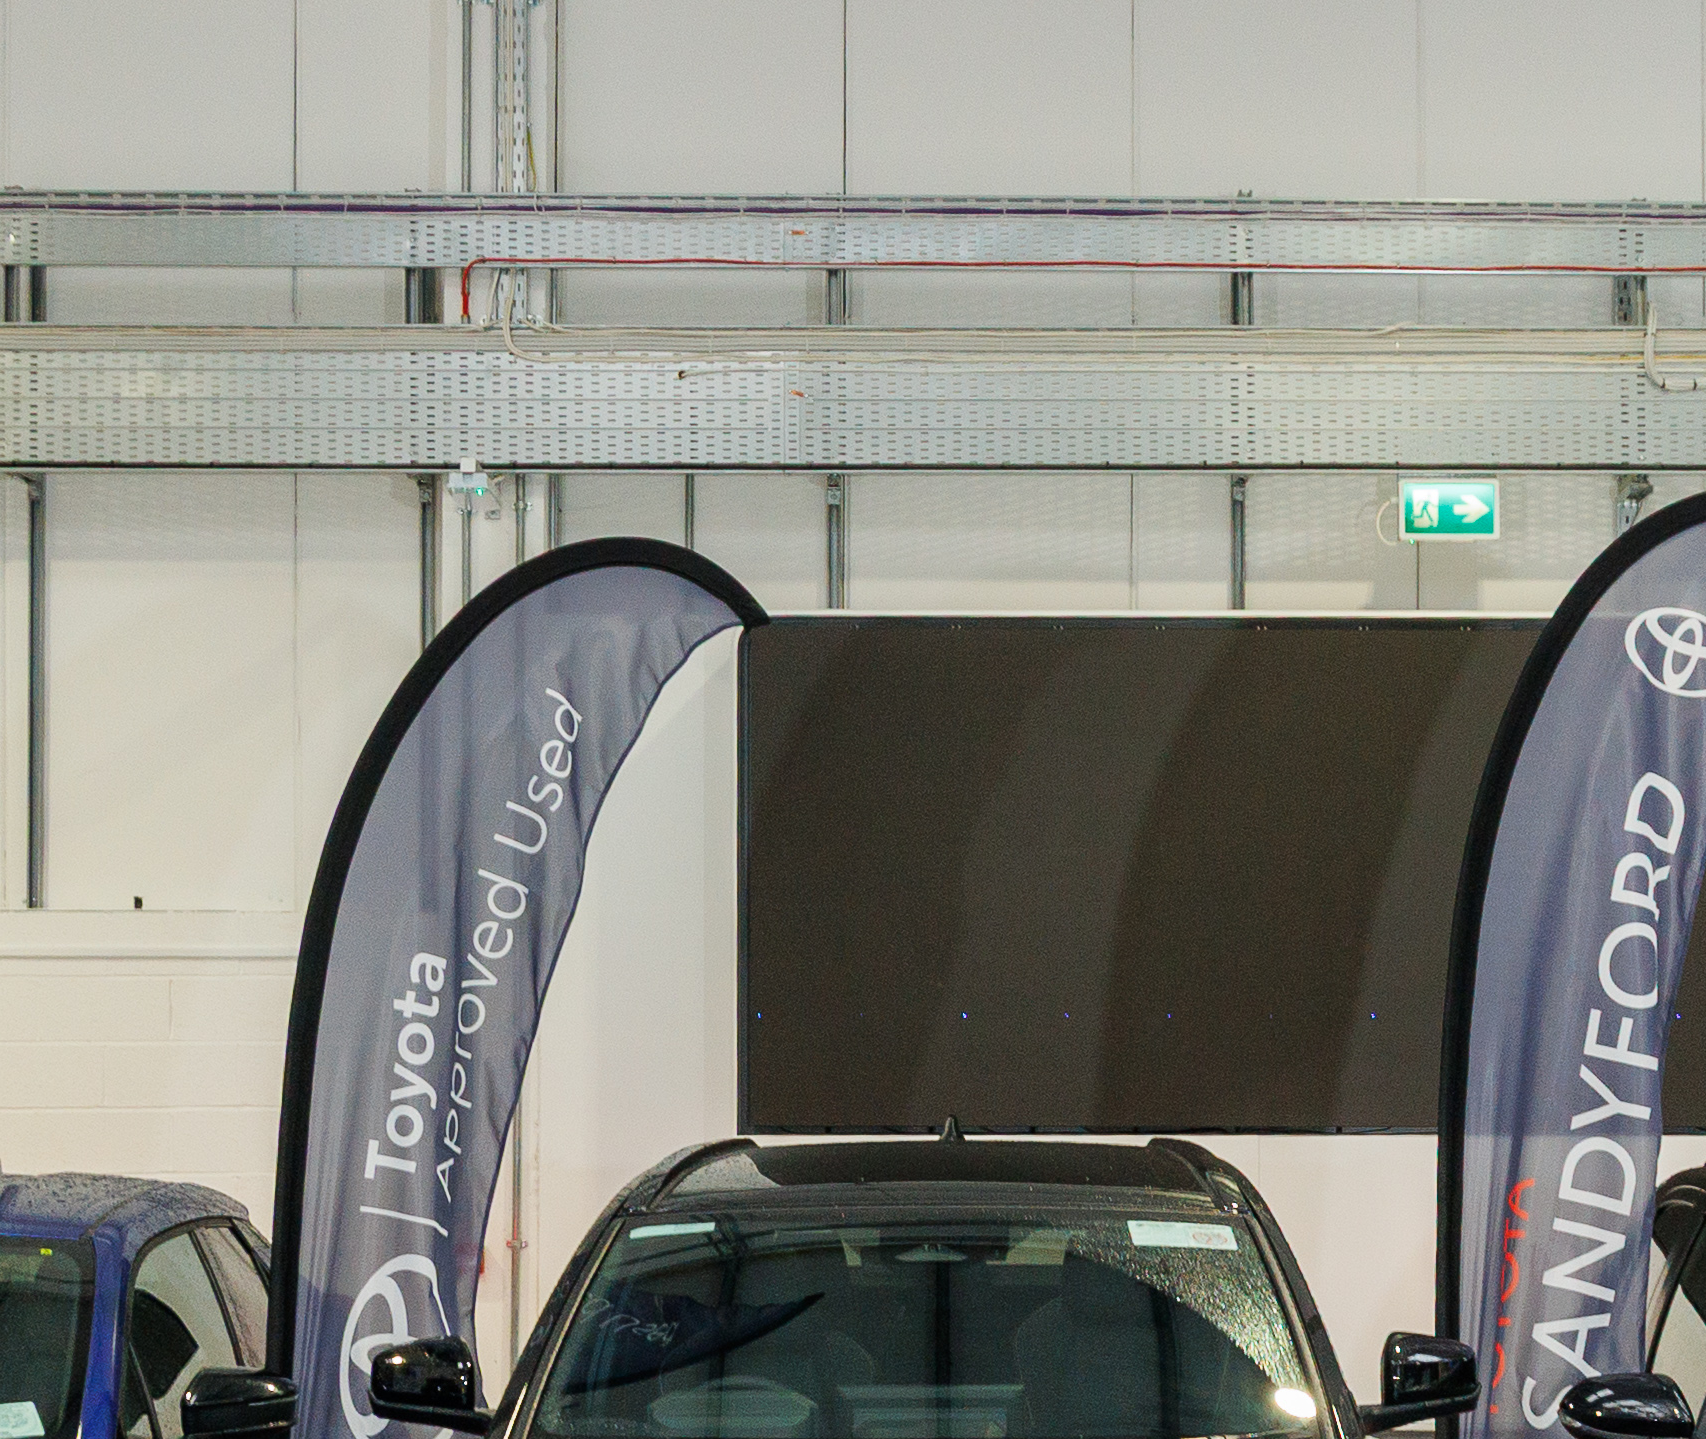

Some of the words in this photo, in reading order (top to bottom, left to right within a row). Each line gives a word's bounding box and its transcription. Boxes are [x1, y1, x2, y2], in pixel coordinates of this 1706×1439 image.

[365, 953, 447, 1179] Toyota
[437, 869, 529, 1203] Approved
[494, 687, 583, 855] Used
